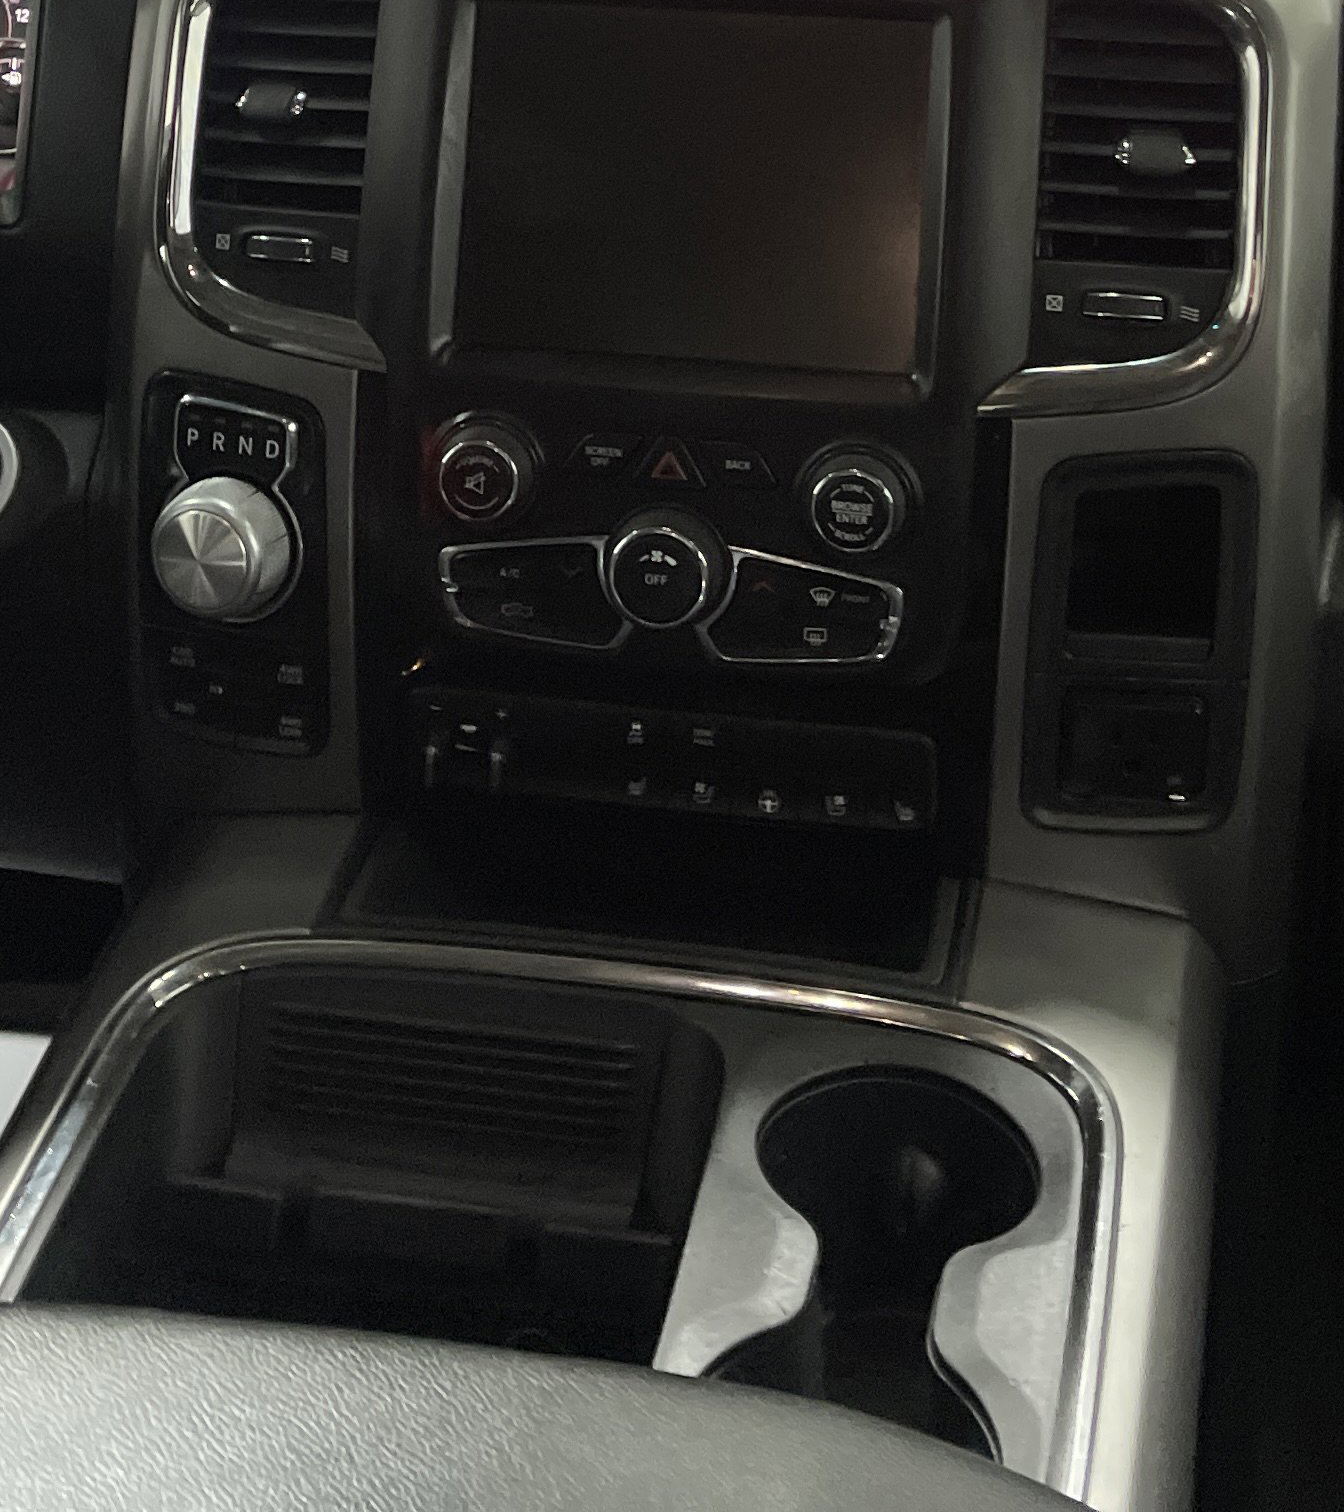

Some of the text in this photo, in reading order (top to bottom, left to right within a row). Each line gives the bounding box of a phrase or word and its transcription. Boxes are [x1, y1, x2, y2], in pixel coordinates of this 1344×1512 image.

[14, 8, 30, 24] 12
[186, 427, 280, 460] P R N D
[725, 459, 752, 471] BACK
[835, 513, 869, 526] ENTER
[643, 572, 669, 587] OFF
